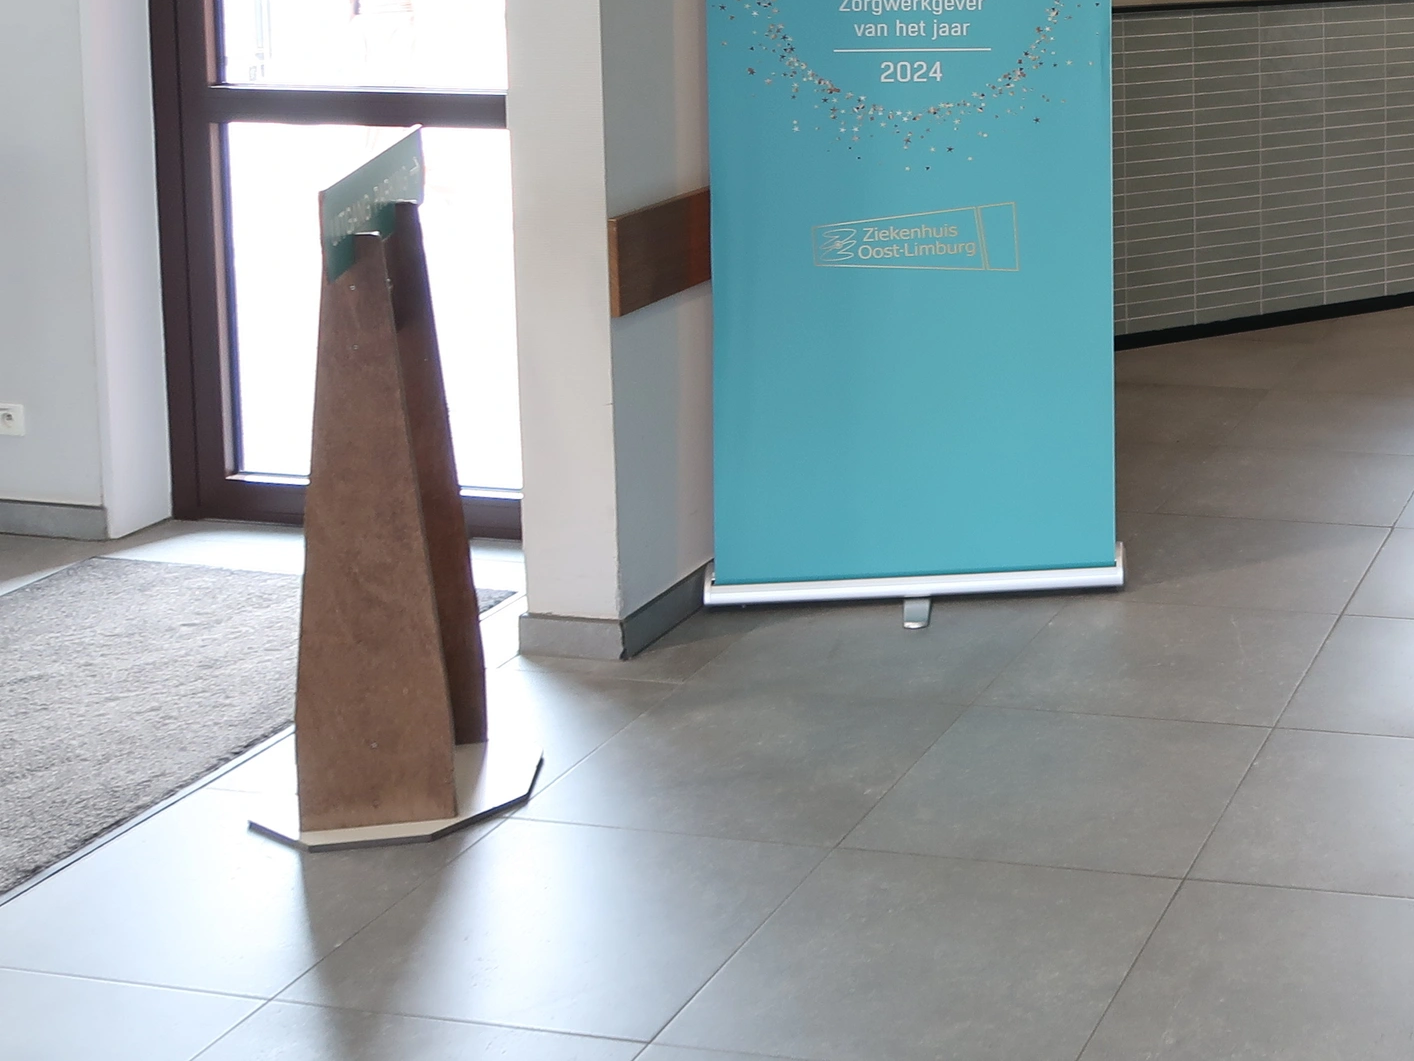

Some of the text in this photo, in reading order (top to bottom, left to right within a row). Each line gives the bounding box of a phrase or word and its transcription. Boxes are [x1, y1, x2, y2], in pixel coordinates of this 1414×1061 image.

[853, 19, 971, 42] van het jaar
[880, 61, 943, 84] 2024
[862, 223, 958, 242] Ziekenhuis
[857, 240, 976, 260] Oost-Limburg
